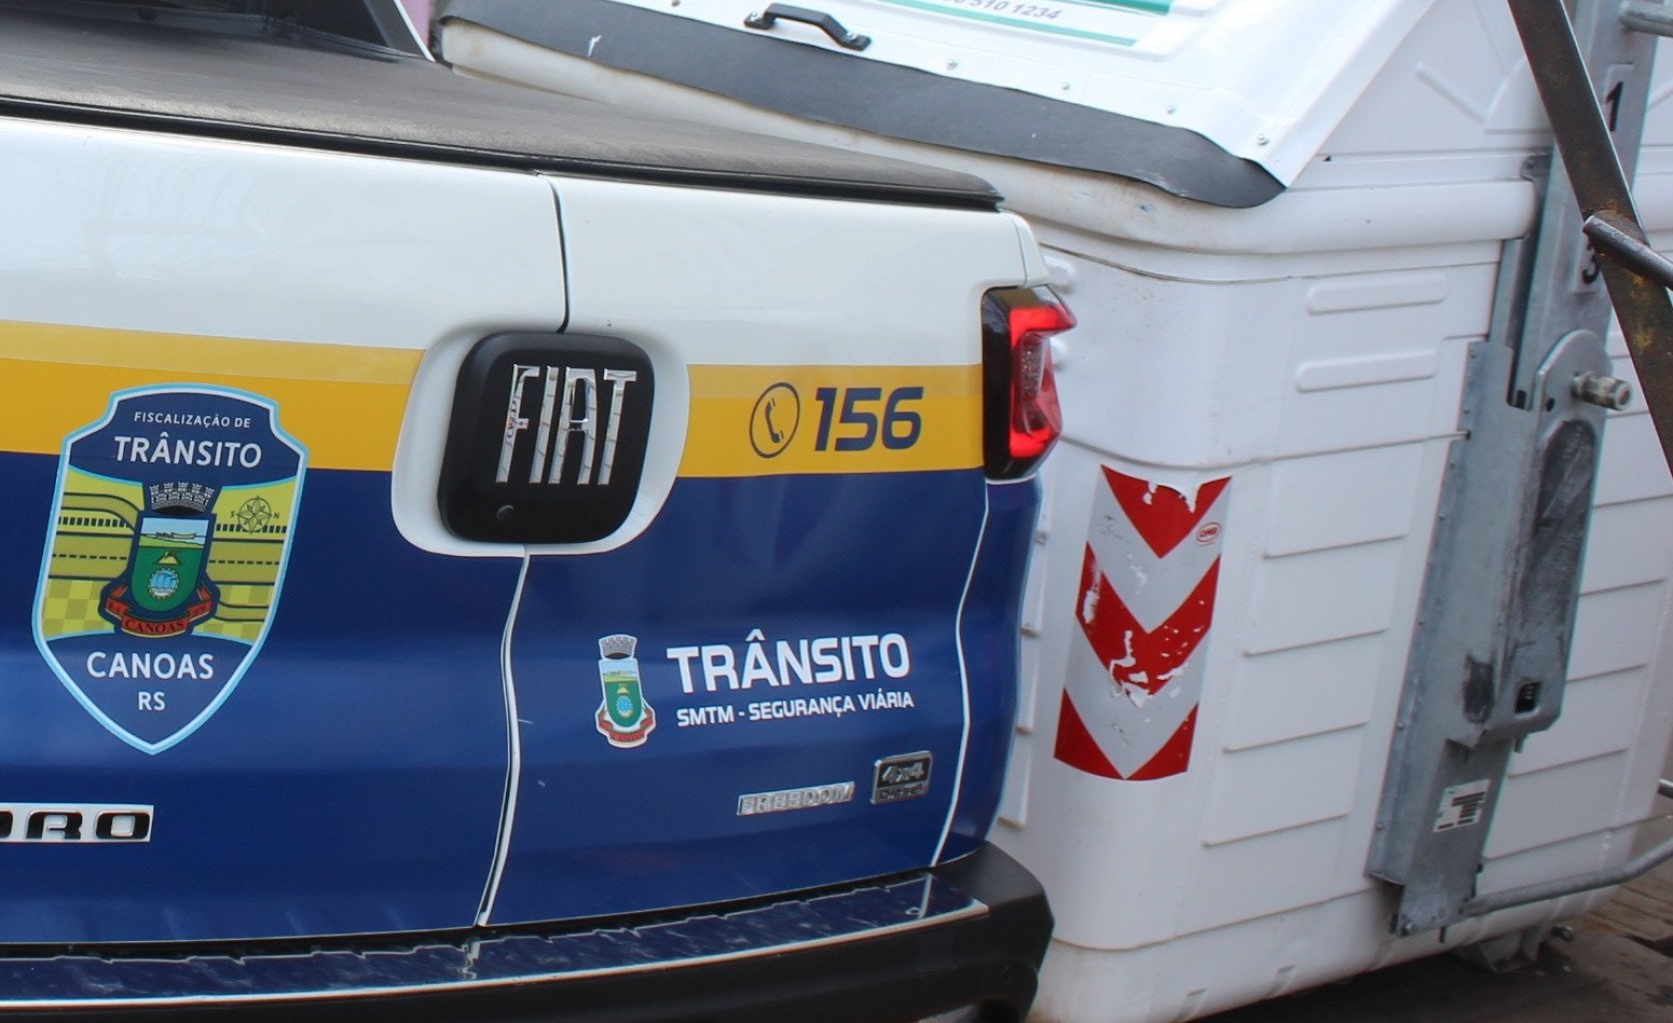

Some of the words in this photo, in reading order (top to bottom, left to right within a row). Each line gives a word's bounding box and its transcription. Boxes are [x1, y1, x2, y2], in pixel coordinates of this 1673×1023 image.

[1012, 3, 1063, 20] 1234
[134, 411, 230, 429] FISCALIZAÇÃO
[234, 417, 251, 429] DE
[495, 363, 637, 485] FIAT
[814, 387, 924, 452] 156
[114, 432, 262, 468] TRÂNSITO
[124, 619, 185, 634] CANOAS
[86, 651, 214, 680] CANOAS
[666, 629, 910, 694] TRÂNSITO
[138, 691, 166, 711] RS
[677, 705, 734, 727] SMTM
[749, 695, 856, 721] SEGURANÇA
[858, 688, 914, 711] VIÁRIA
[738, 781, 855, 815] FREEDOM
